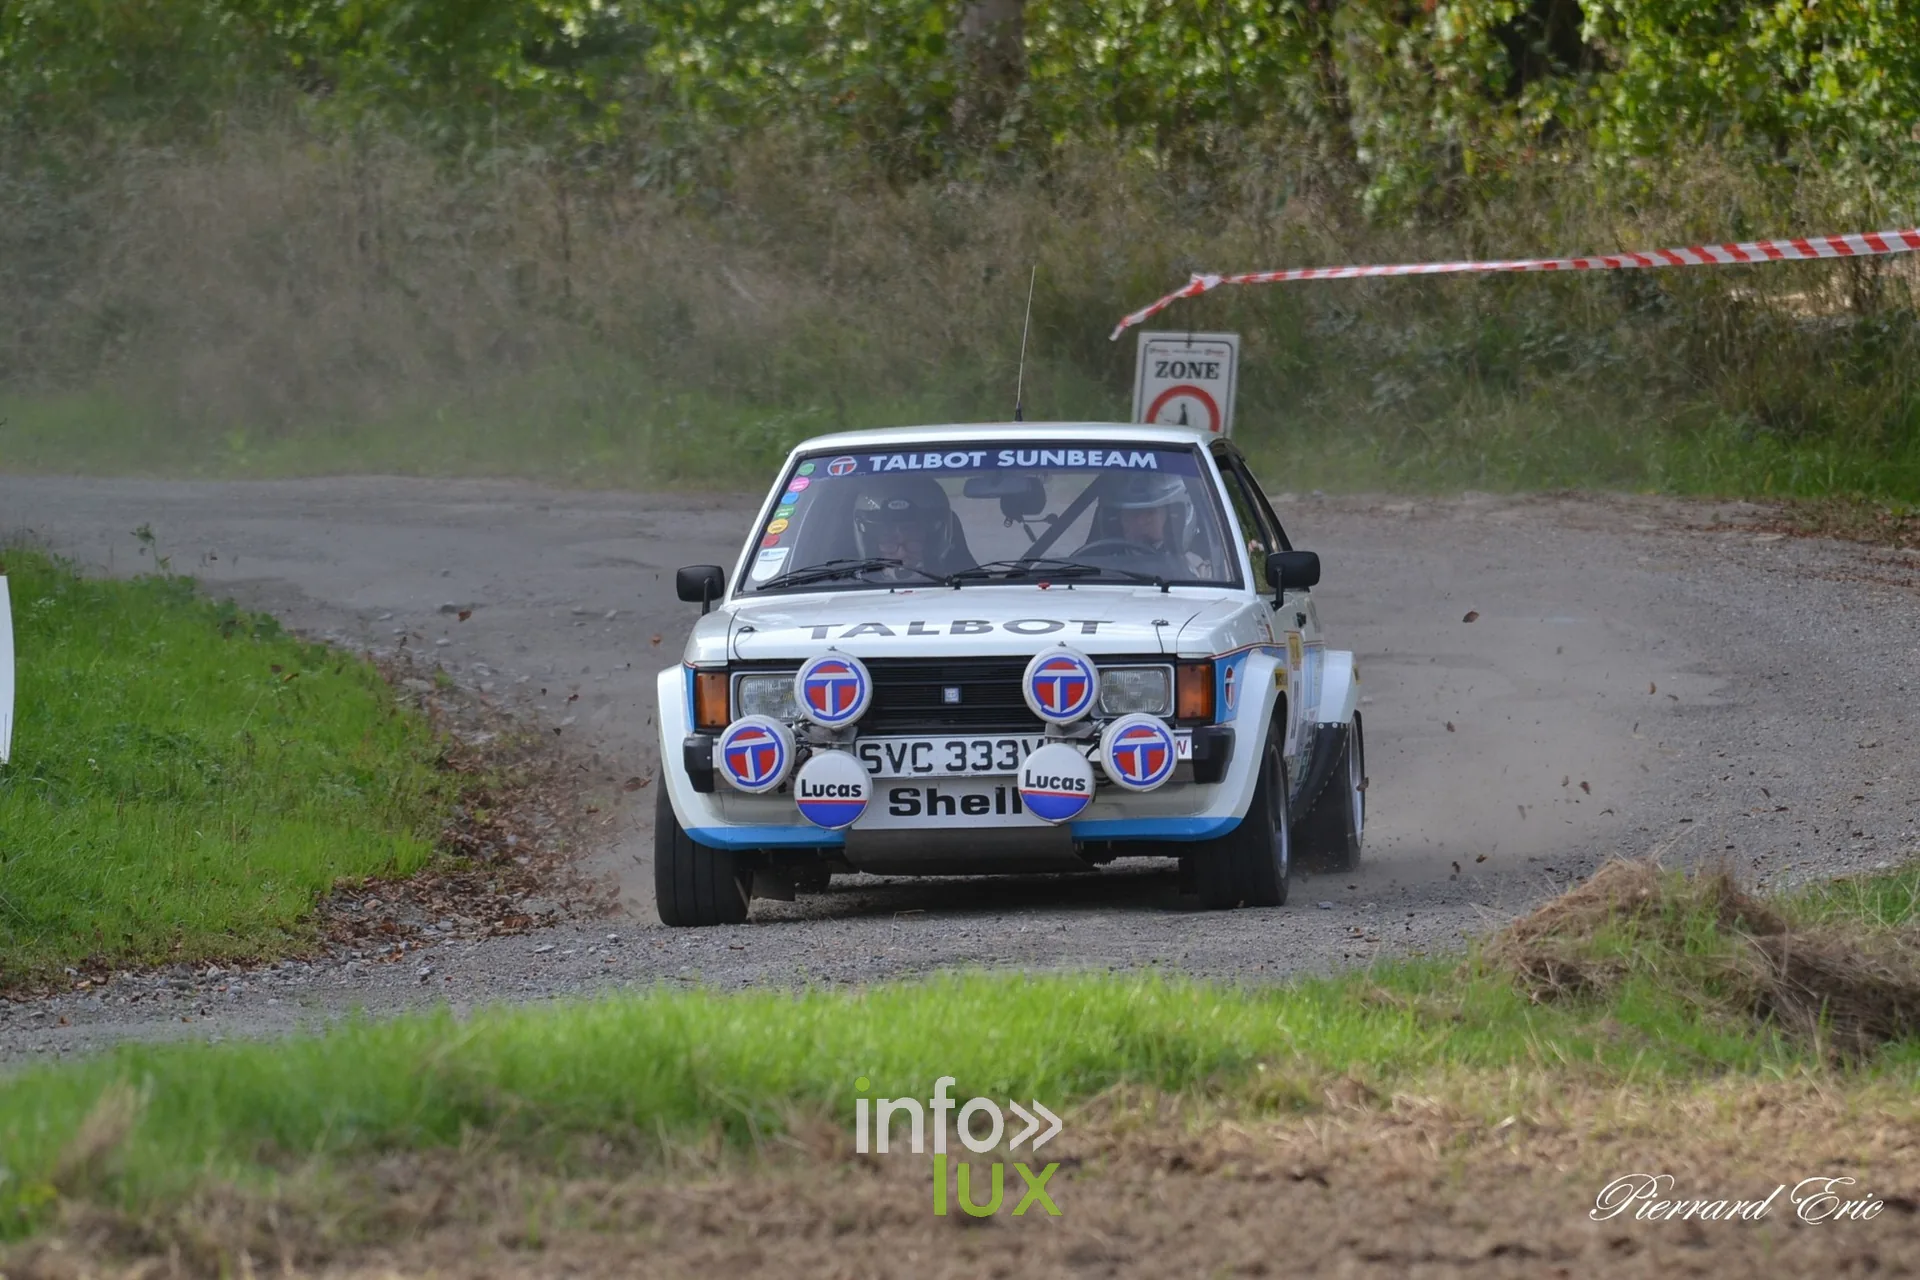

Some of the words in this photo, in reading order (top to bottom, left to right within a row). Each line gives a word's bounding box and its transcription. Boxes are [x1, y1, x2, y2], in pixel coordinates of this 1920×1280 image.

[1155, 361, 1219, 379] ZONE
[869, 451, 987, 471] TALBOT
[997, 449, 1158, 469] SUNBEAM
[799, 618, 1115, 640] TALBOT
[859, 742, 933, 774] SVC
[801, 779, 862, 798] Lucas
[1025, 769, 1086, 791] Lucas
[889, 787, 1022, 815] Shell
